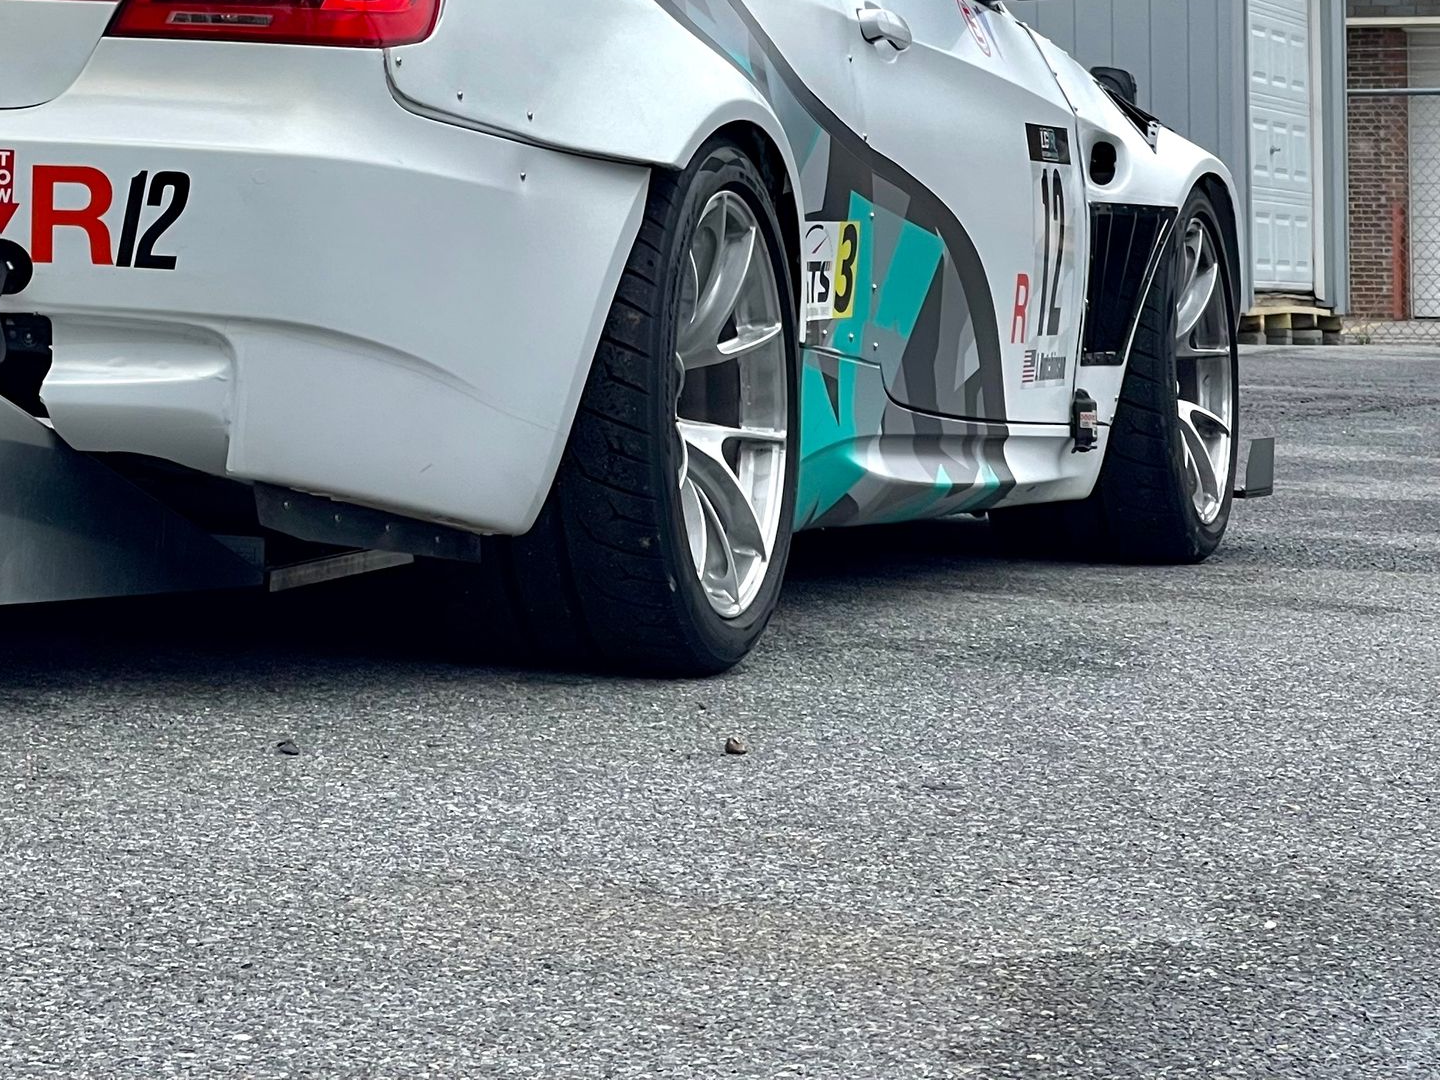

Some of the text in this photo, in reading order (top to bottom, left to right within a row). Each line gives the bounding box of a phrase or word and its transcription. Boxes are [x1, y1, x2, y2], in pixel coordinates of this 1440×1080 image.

[806, 223, 858, 313] TS 3
[1037, 168, 1065, 336] 12
[1010, 273, 1030, 344] R
